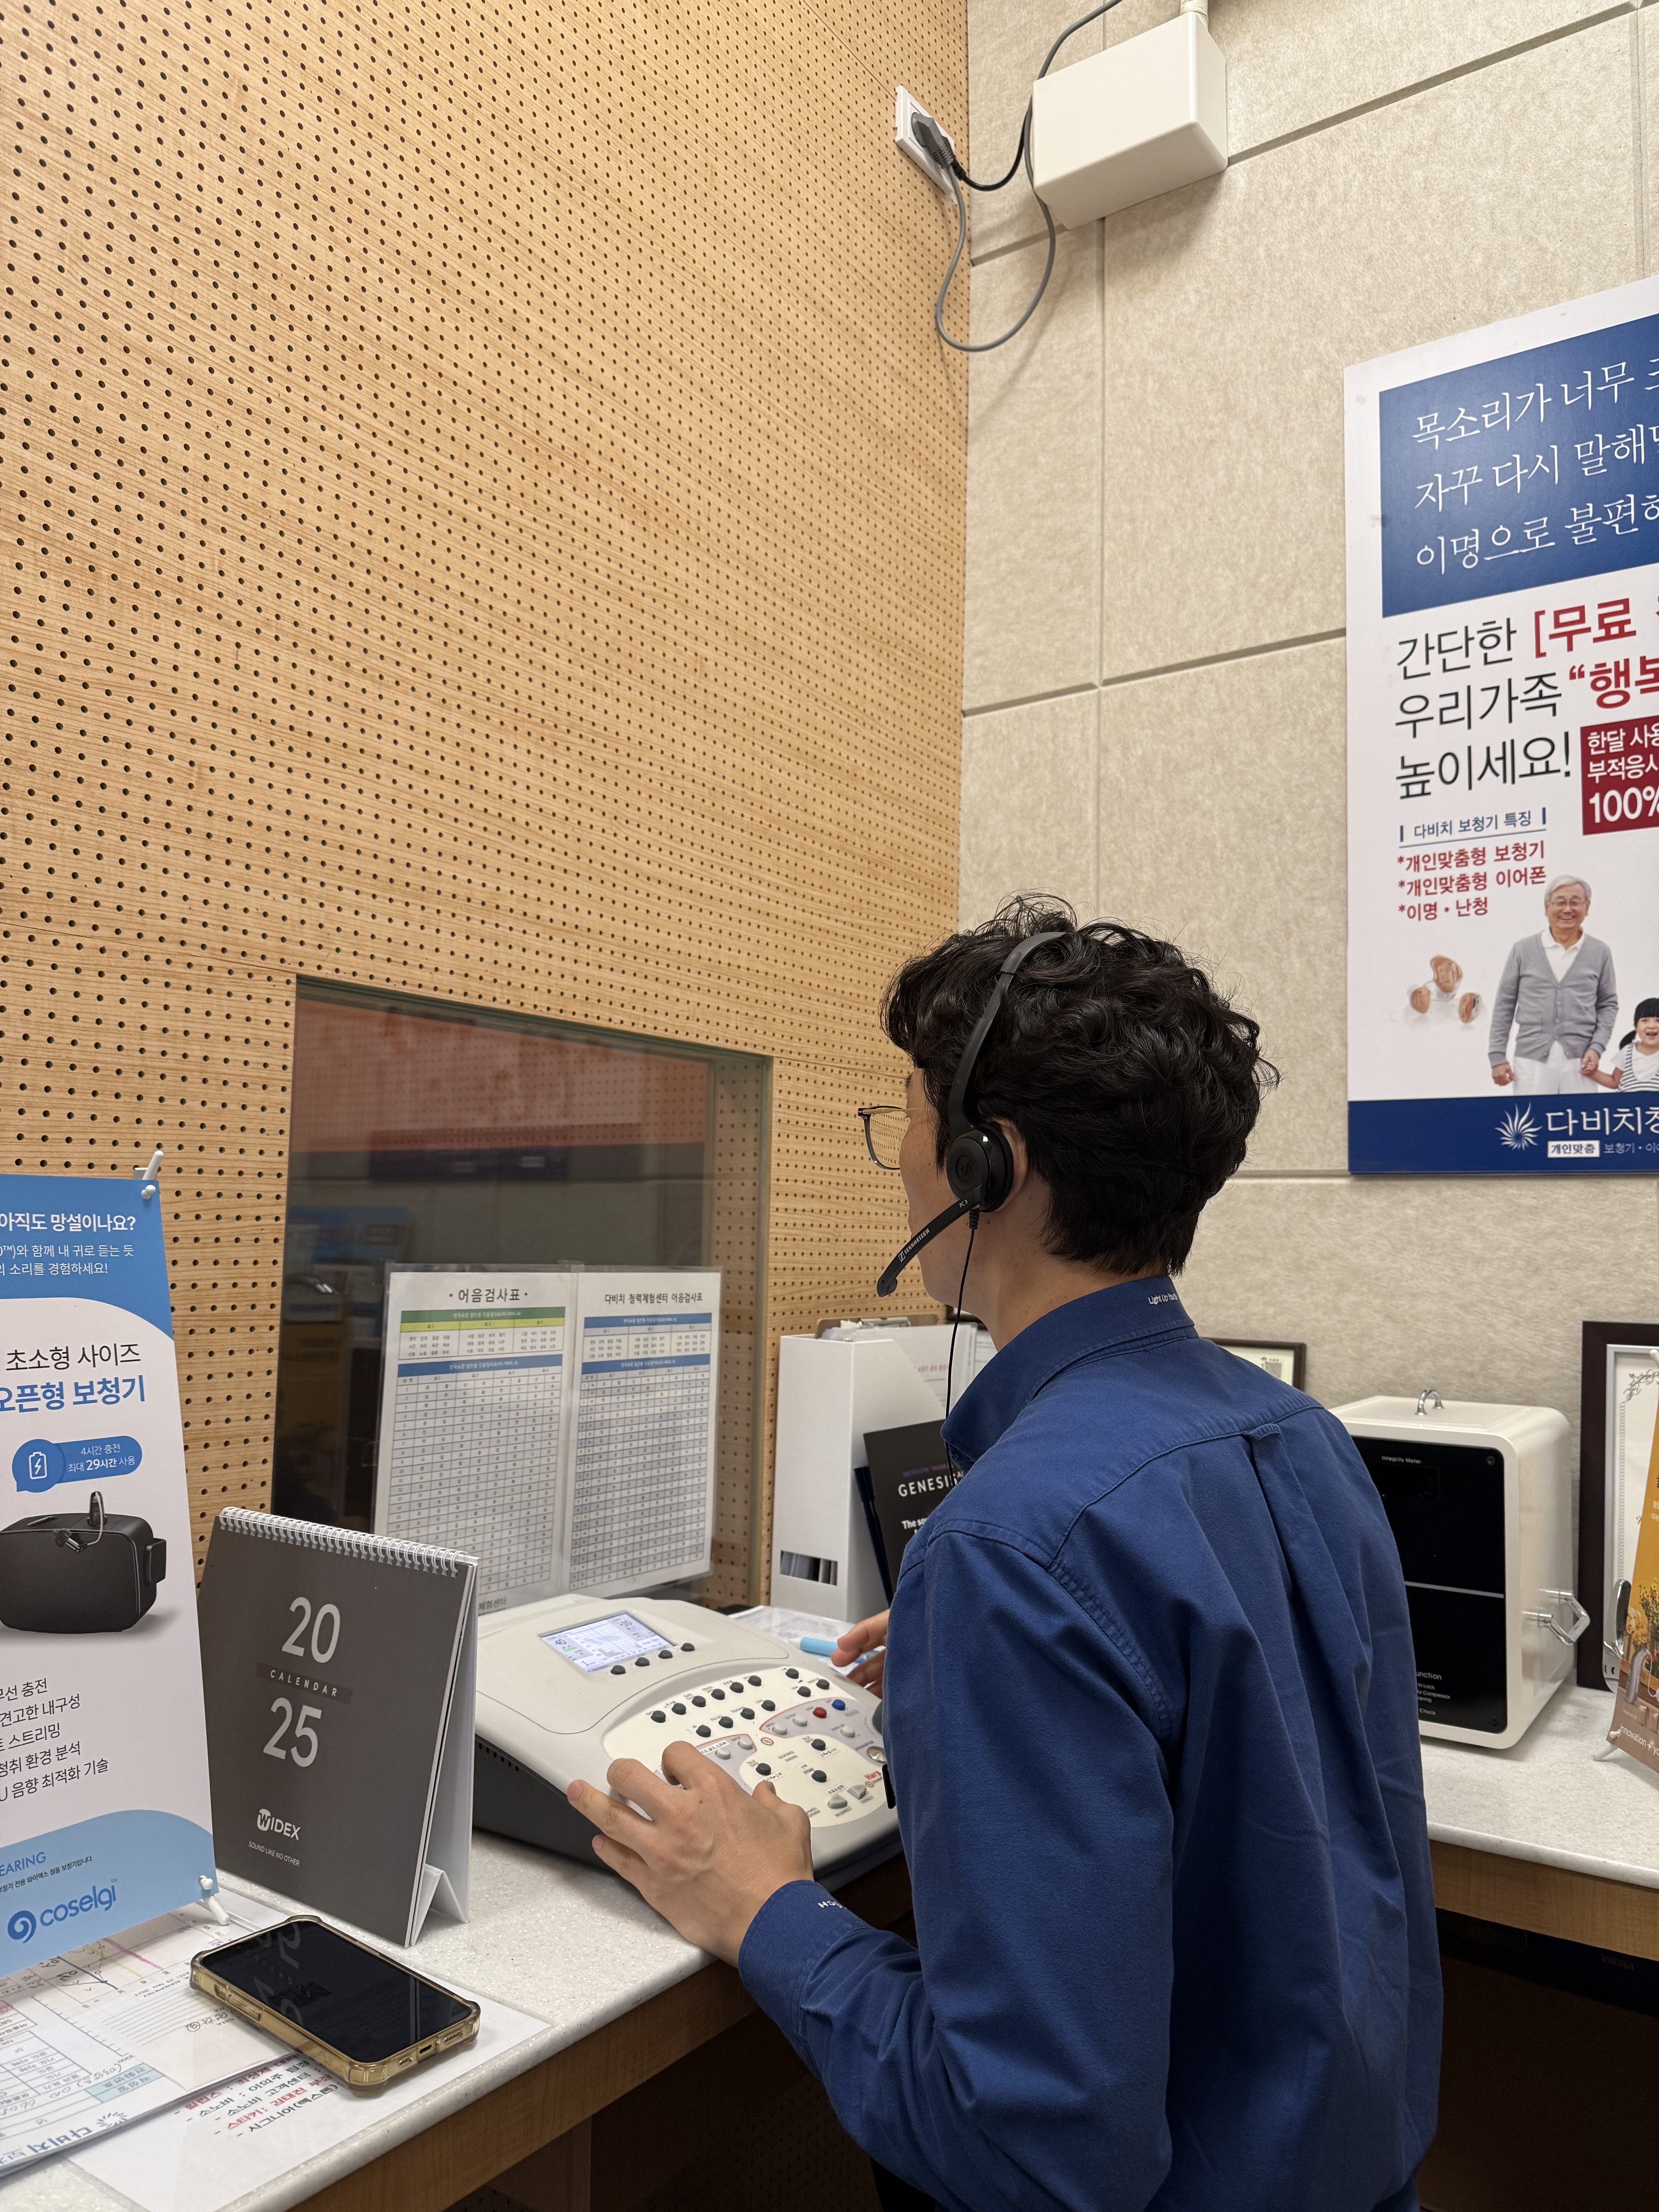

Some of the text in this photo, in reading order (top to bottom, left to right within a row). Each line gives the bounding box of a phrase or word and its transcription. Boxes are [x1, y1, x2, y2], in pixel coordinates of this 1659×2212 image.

[1412, 383, 1552, 450] 목소리가
[1561, 362, 1635, 410] 너무
[1414, 424, 1659, 512] 자꾸 다시 말해
[1396, 617, 1516, 680] 간단한
[1395, 672, 1561, 739] 우리가족
[1587, 728, 1626, 755] 한달
[1396, 732, 1571, 800] 높이세요!
[1414, 811, 1531, 838] 다비치 보청기 특징
[1494, 840, 1544, 862] 보청기
[1496, 866, 1546, 888] 이어폰
[1456, 896, 1488, 917] 난청
[1551, 1143, 1595, 1154] 개인맞춤
[1603, 1143, 1635, 1154] 보청기
[0, 1212, 136, 1232] 아직도 망설이나요?
[32, 1245, 134, 1258] 함께 내 귀로 듣는 듯
[904, 1228, 930, 1255] SENNHEISER
[9, 1262, 45, 1276] 소리를
[48, 1262, 108, 1275] 경험하세요!
[458, 1288, 520, 1303] 어음검사표
[605, 1292, 702, 1304] 다비치 청력체험센터 어음검사표
[6, 1343, 141, 1370] 초소형 사이즈
[73, 1375, 145, 1405] 보청기
[81, 1443, 120, 1456] 4시간 충전
[68, 1456, 136, 1473] 최대 29시간 사용
[902, 1520, 917, 1529] The
[282, 1596, 340, 1663] 20
[22, 1678, 48, 1697] 충전
[270, 1670, 338, 1697] CALENDAR
[1417, 1671, 1442, 1680] unction
[0, 1693, 80, 1727] 견고한 내구성
[8, 1723, 60, 1749] 스트리밍
[263, 1697, 322, 1767] 25
[1620, 1723, 1647, 1747] innovation
[26, 1749, 52, 1769] 환경
[55, 1741, 80, 1761] 분석
[12, 1758, 108, 1798] 음향 최적화 기술
[864, 1770, 882, 1780] Harp
[257, 1808, 301, 1840] WIDEX
[248, 1841, 300, 1867] SOUND LIKE NO OTHER
[15, 1879, 26, 1888] 전용
[27, 1871, 49, 1883] 와이덱스
[62, 1855, 94, 1871] 보청기입니다.
[40, 1885, 116, 1927] coselgi
[199, 2060, 310, 2118] 소노바 이의주 팀장
[227, 2073, 311, 2116] 소노바 고객센터
[27, 2126, 92, 2153] 다비치
